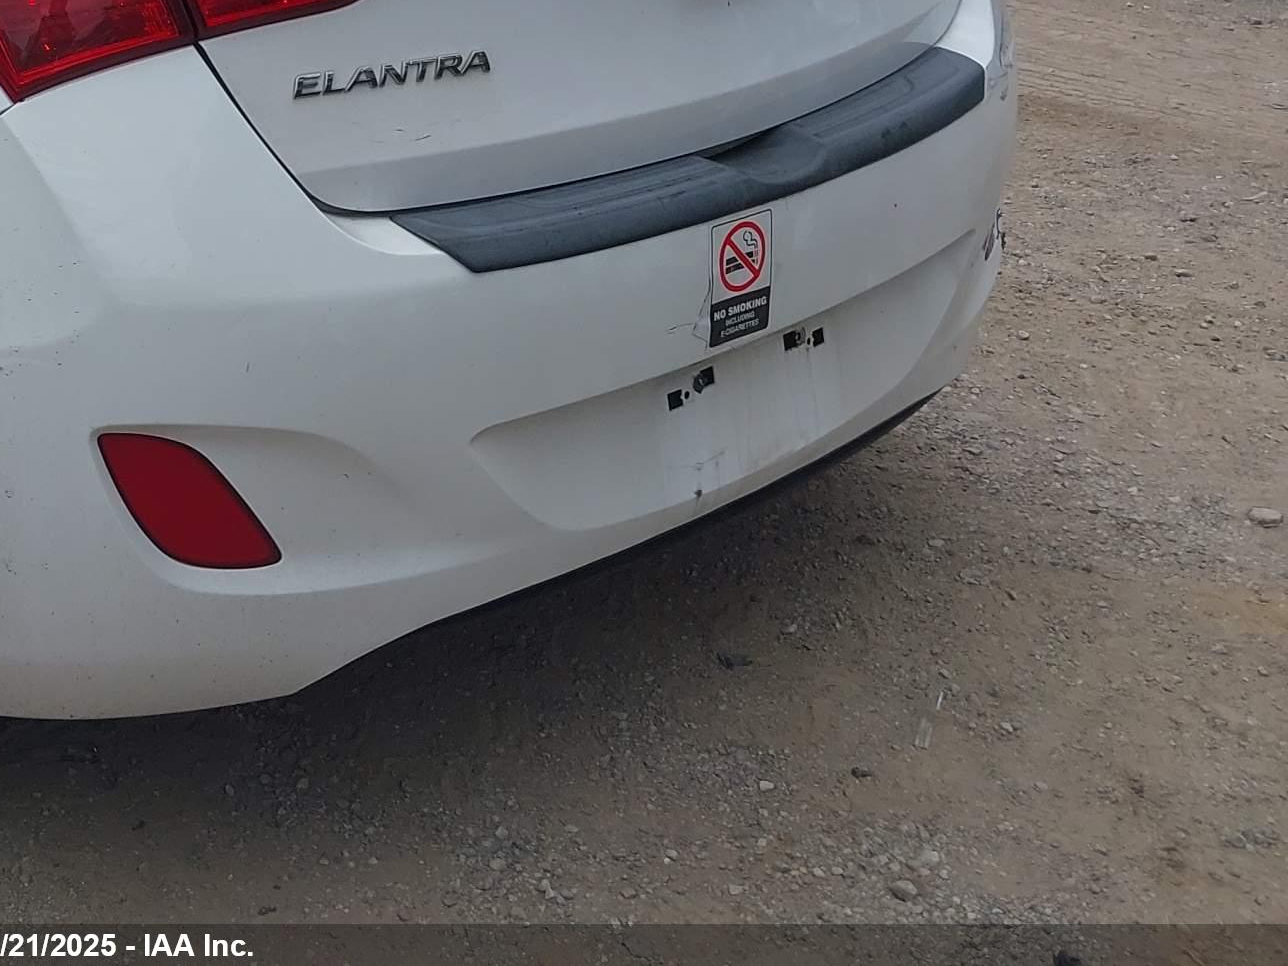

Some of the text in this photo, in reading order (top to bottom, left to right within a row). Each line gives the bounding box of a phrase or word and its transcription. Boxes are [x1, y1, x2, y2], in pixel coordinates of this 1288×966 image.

[292, 49, 492, 100] ELANTRA
[713, 296, 767, 322] NO SMOKING
